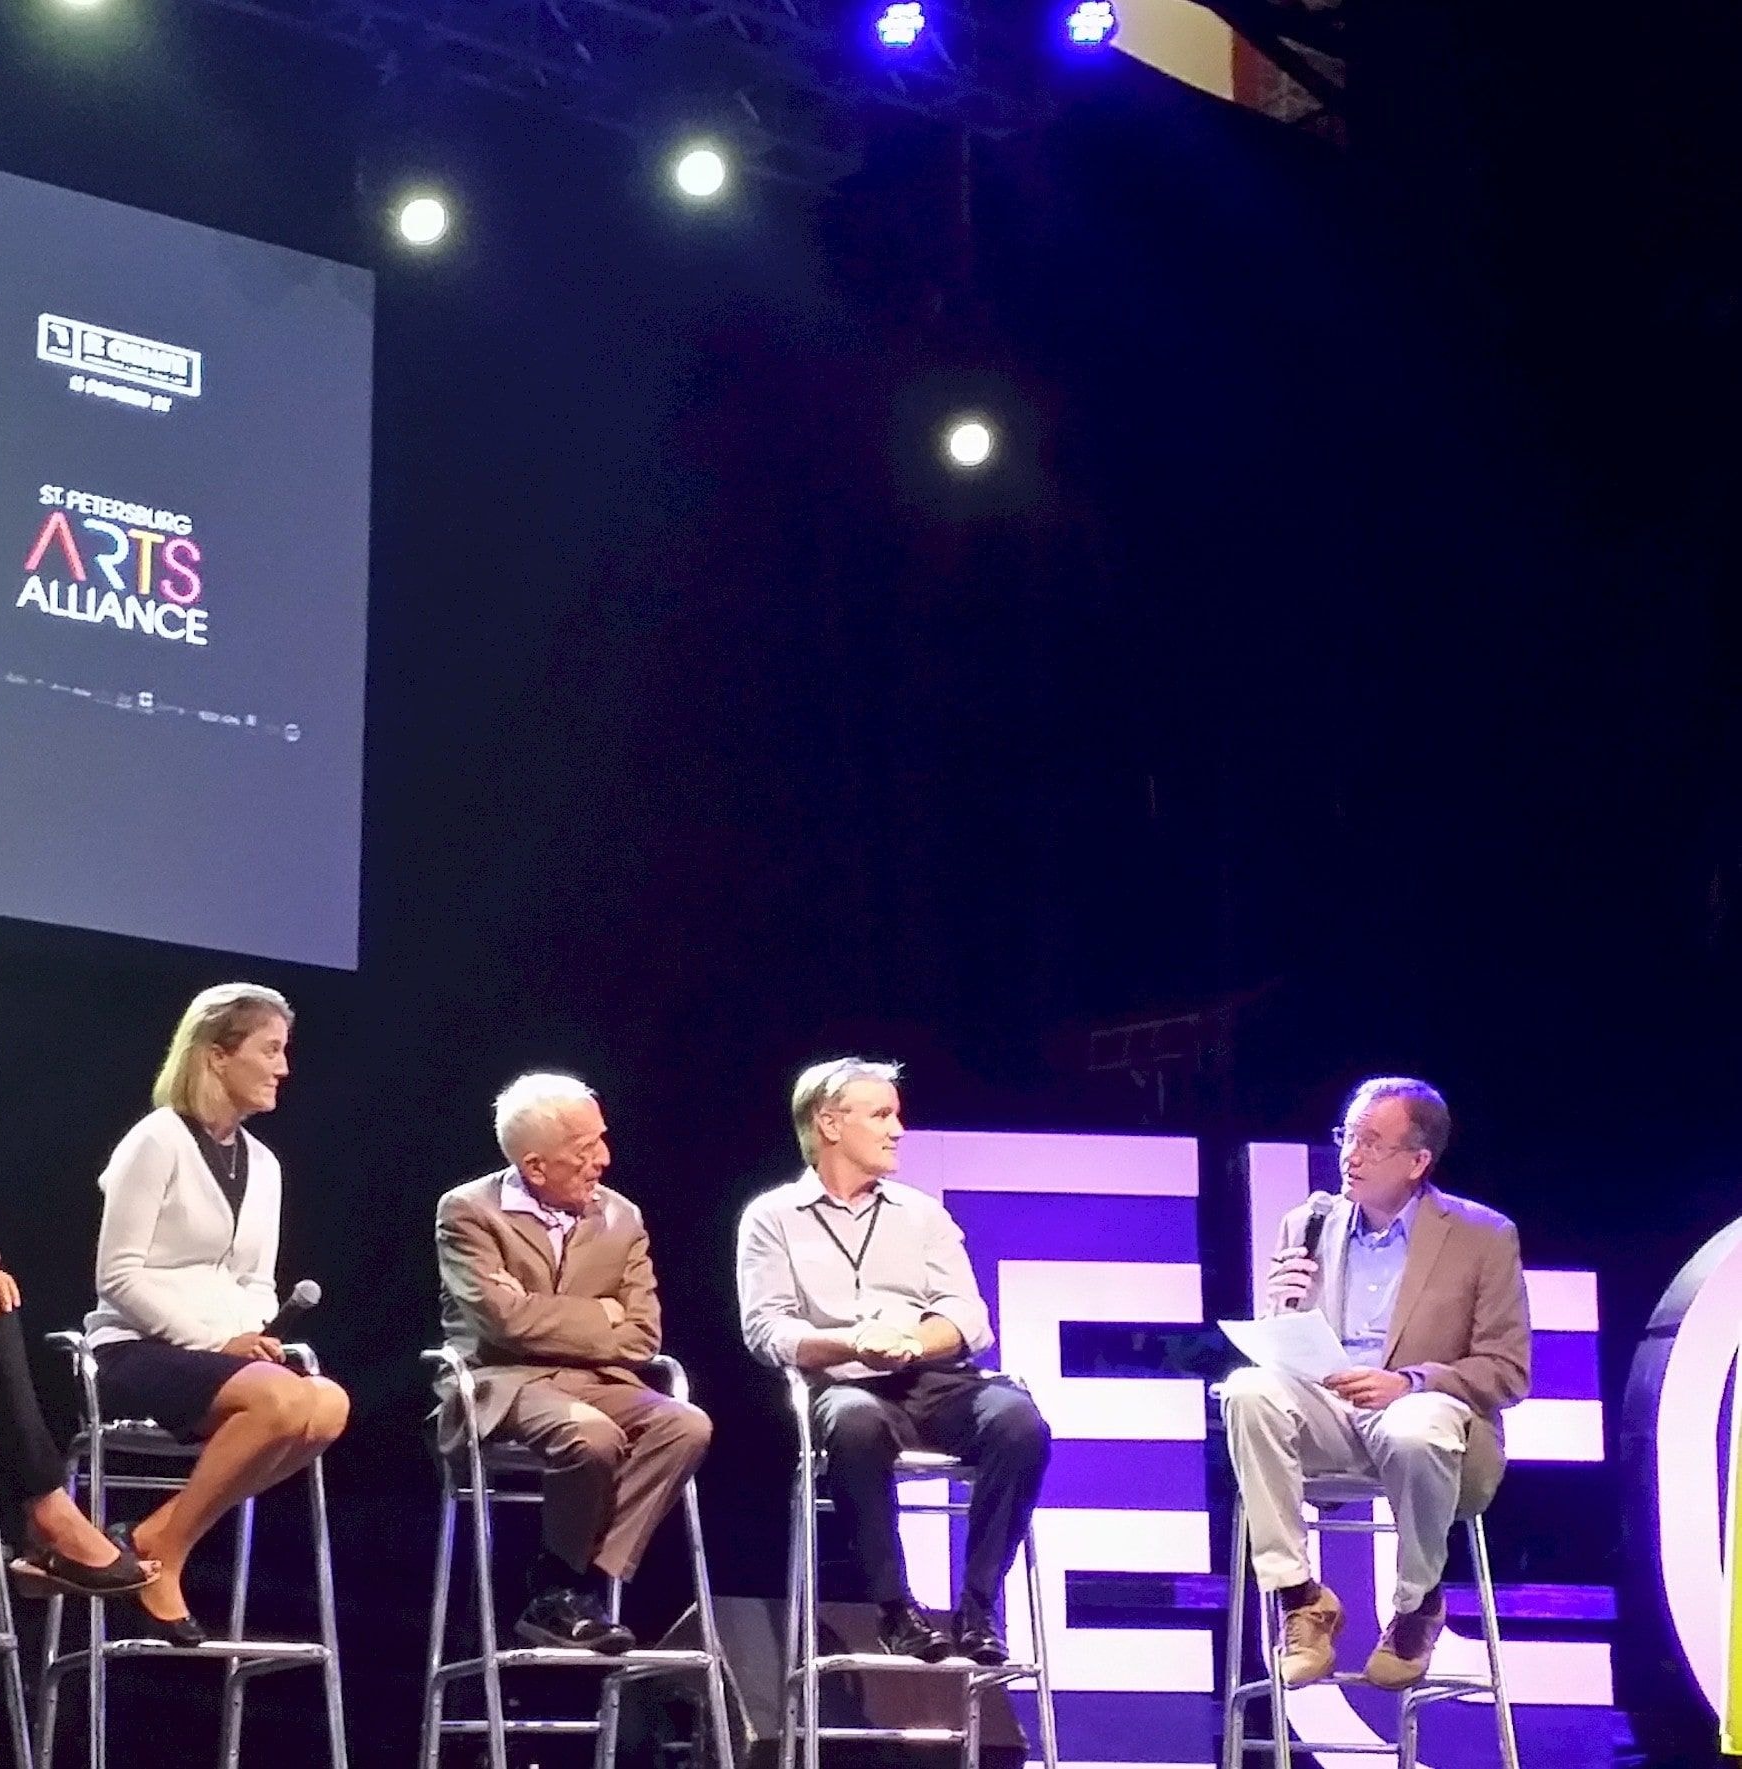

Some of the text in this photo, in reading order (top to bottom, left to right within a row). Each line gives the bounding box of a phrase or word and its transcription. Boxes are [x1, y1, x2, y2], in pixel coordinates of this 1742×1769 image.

[66, 489, 193, 536] PETERSBURG
[23, 511, 202, 605] ARTS
[15, 574, 209, 646] ALLIANCE
